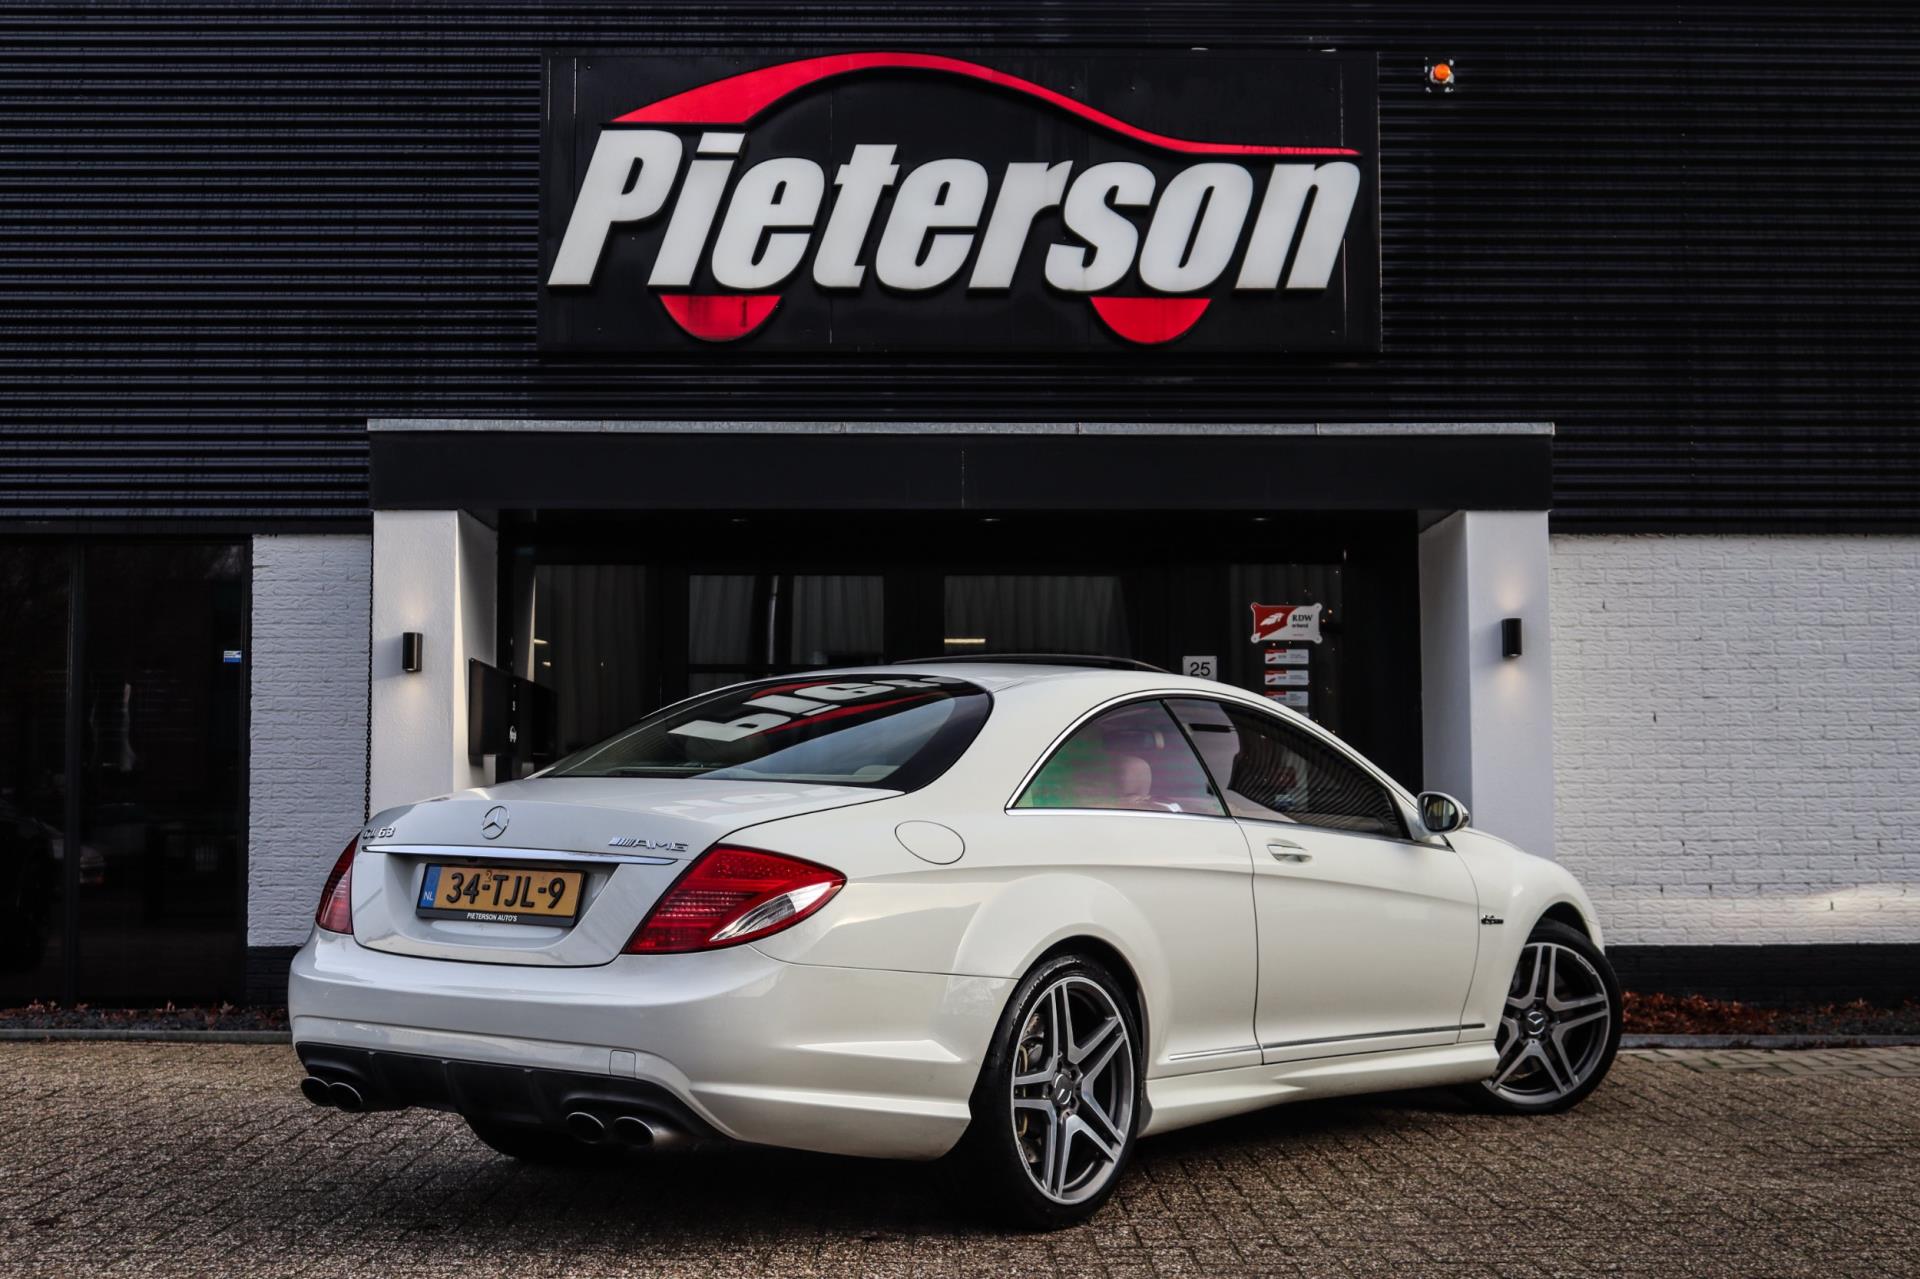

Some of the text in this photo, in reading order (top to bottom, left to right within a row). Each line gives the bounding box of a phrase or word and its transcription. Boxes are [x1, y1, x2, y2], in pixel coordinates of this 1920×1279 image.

[546, 128, 1361, 292] Pieterson
[1190, 662, 1211, 676] 25
[378, 826, 395, 838] 63
[423, 891, 434, 901] NL
[446, 872, 566, 909] 34-TJL-9
[466, 912, 518, 922] PIETERSON AUTO'S
